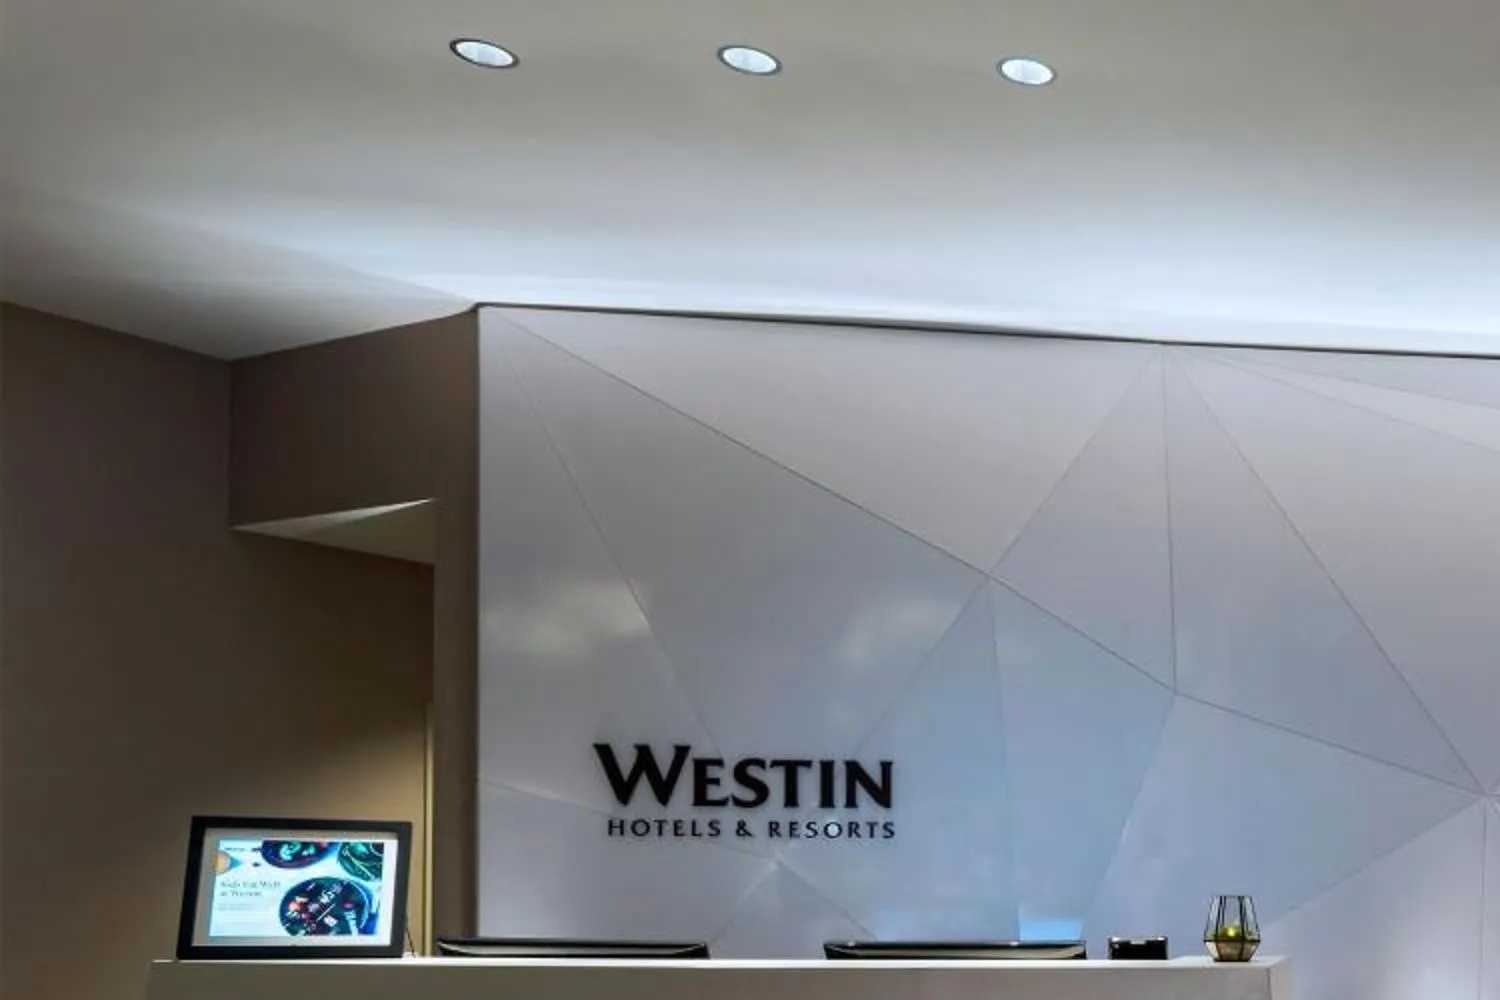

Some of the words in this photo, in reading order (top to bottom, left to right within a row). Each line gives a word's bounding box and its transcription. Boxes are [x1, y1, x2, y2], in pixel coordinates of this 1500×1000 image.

[607, 818, 722, 838] HOTELS
[735, 819, 753, 838] &
[768, 820, 896, 839] RESORTS
